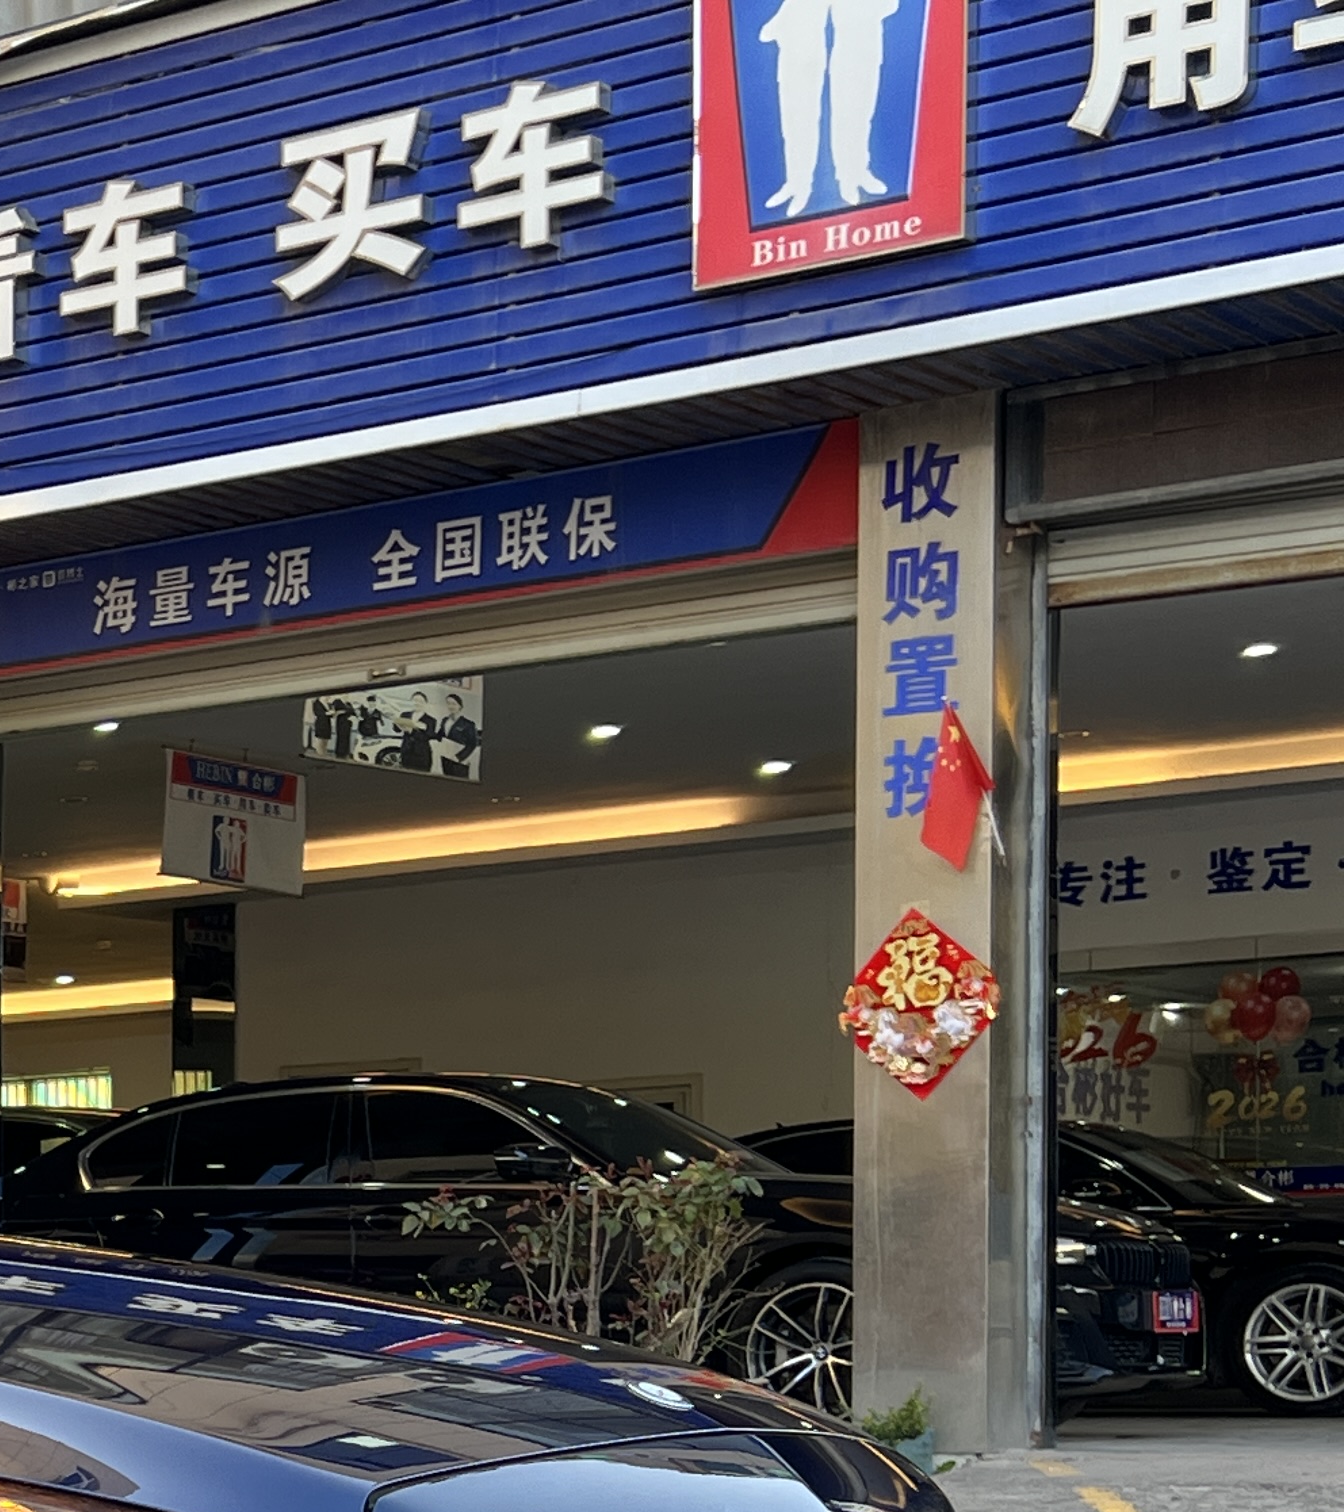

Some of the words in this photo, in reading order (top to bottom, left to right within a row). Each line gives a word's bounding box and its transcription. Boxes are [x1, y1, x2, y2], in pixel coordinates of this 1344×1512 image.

[1068, 0, 1344, 138] 用
[273, 79, 614, 303] 买车
[750, 235, 809, 268] Bin
[824, 212, 923, 253] Home
[92, 545, 314, 637] 海量车源
[371, 494, 618, 594] 全国联保
[876, 931, 954, 1011] 福
[1206, 1085, 1308, 1130] 2026
